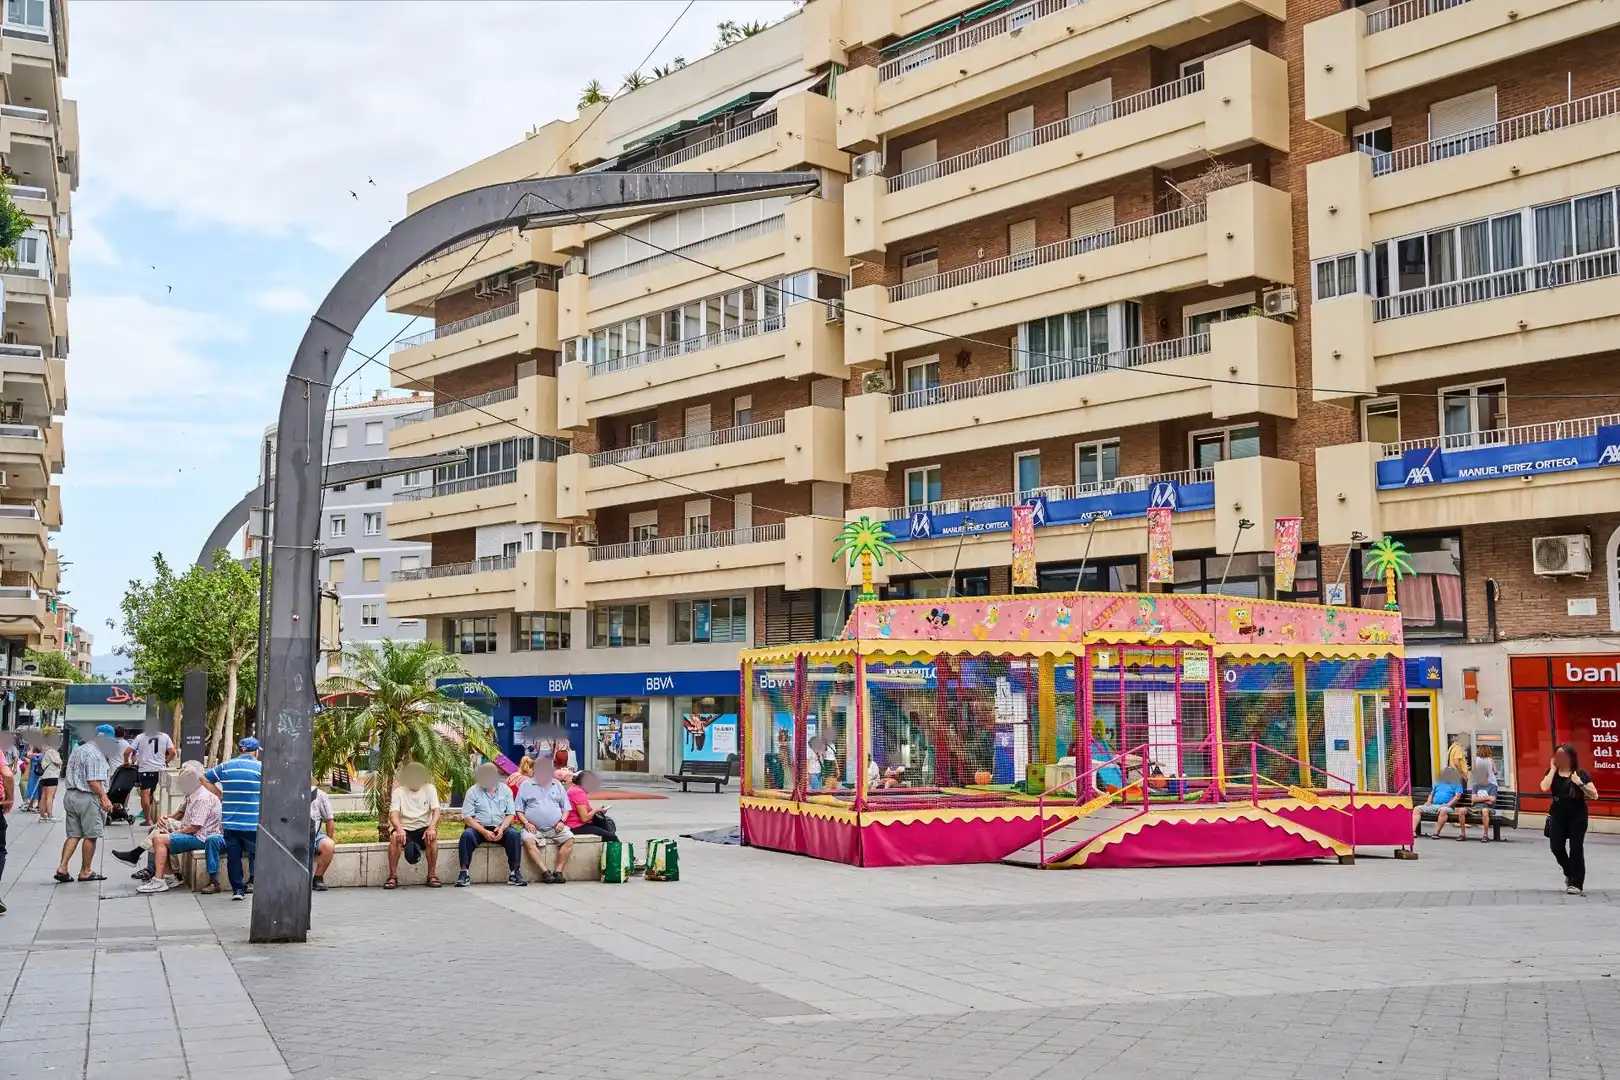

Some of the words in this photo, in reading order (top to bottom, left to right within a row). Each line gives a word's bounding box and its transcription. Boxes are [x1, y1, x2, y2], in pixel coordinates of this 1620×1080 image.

[1599, 444, 1620, 463] AX
[1459, 466, 1500, 478] MANUEL
[1502, 462, 1532, 473] PEREZ
[1535, 457, 1578, 470] ORTEGA
[1404, 466, 1434, 484] AXA
[942, 525, 966, 534] MANUE
[985, 521, 1010, 530] ORTEGA
[1565, 662, 1620, 682] ban
[549, 678, 573, 692] BBVA
[646, 675, 674, 690] BBVA
[1591, 717, 1617, 728] Uno
[1592, 731, 1619, 743] más
[1593, 746, 1613, 757] del
